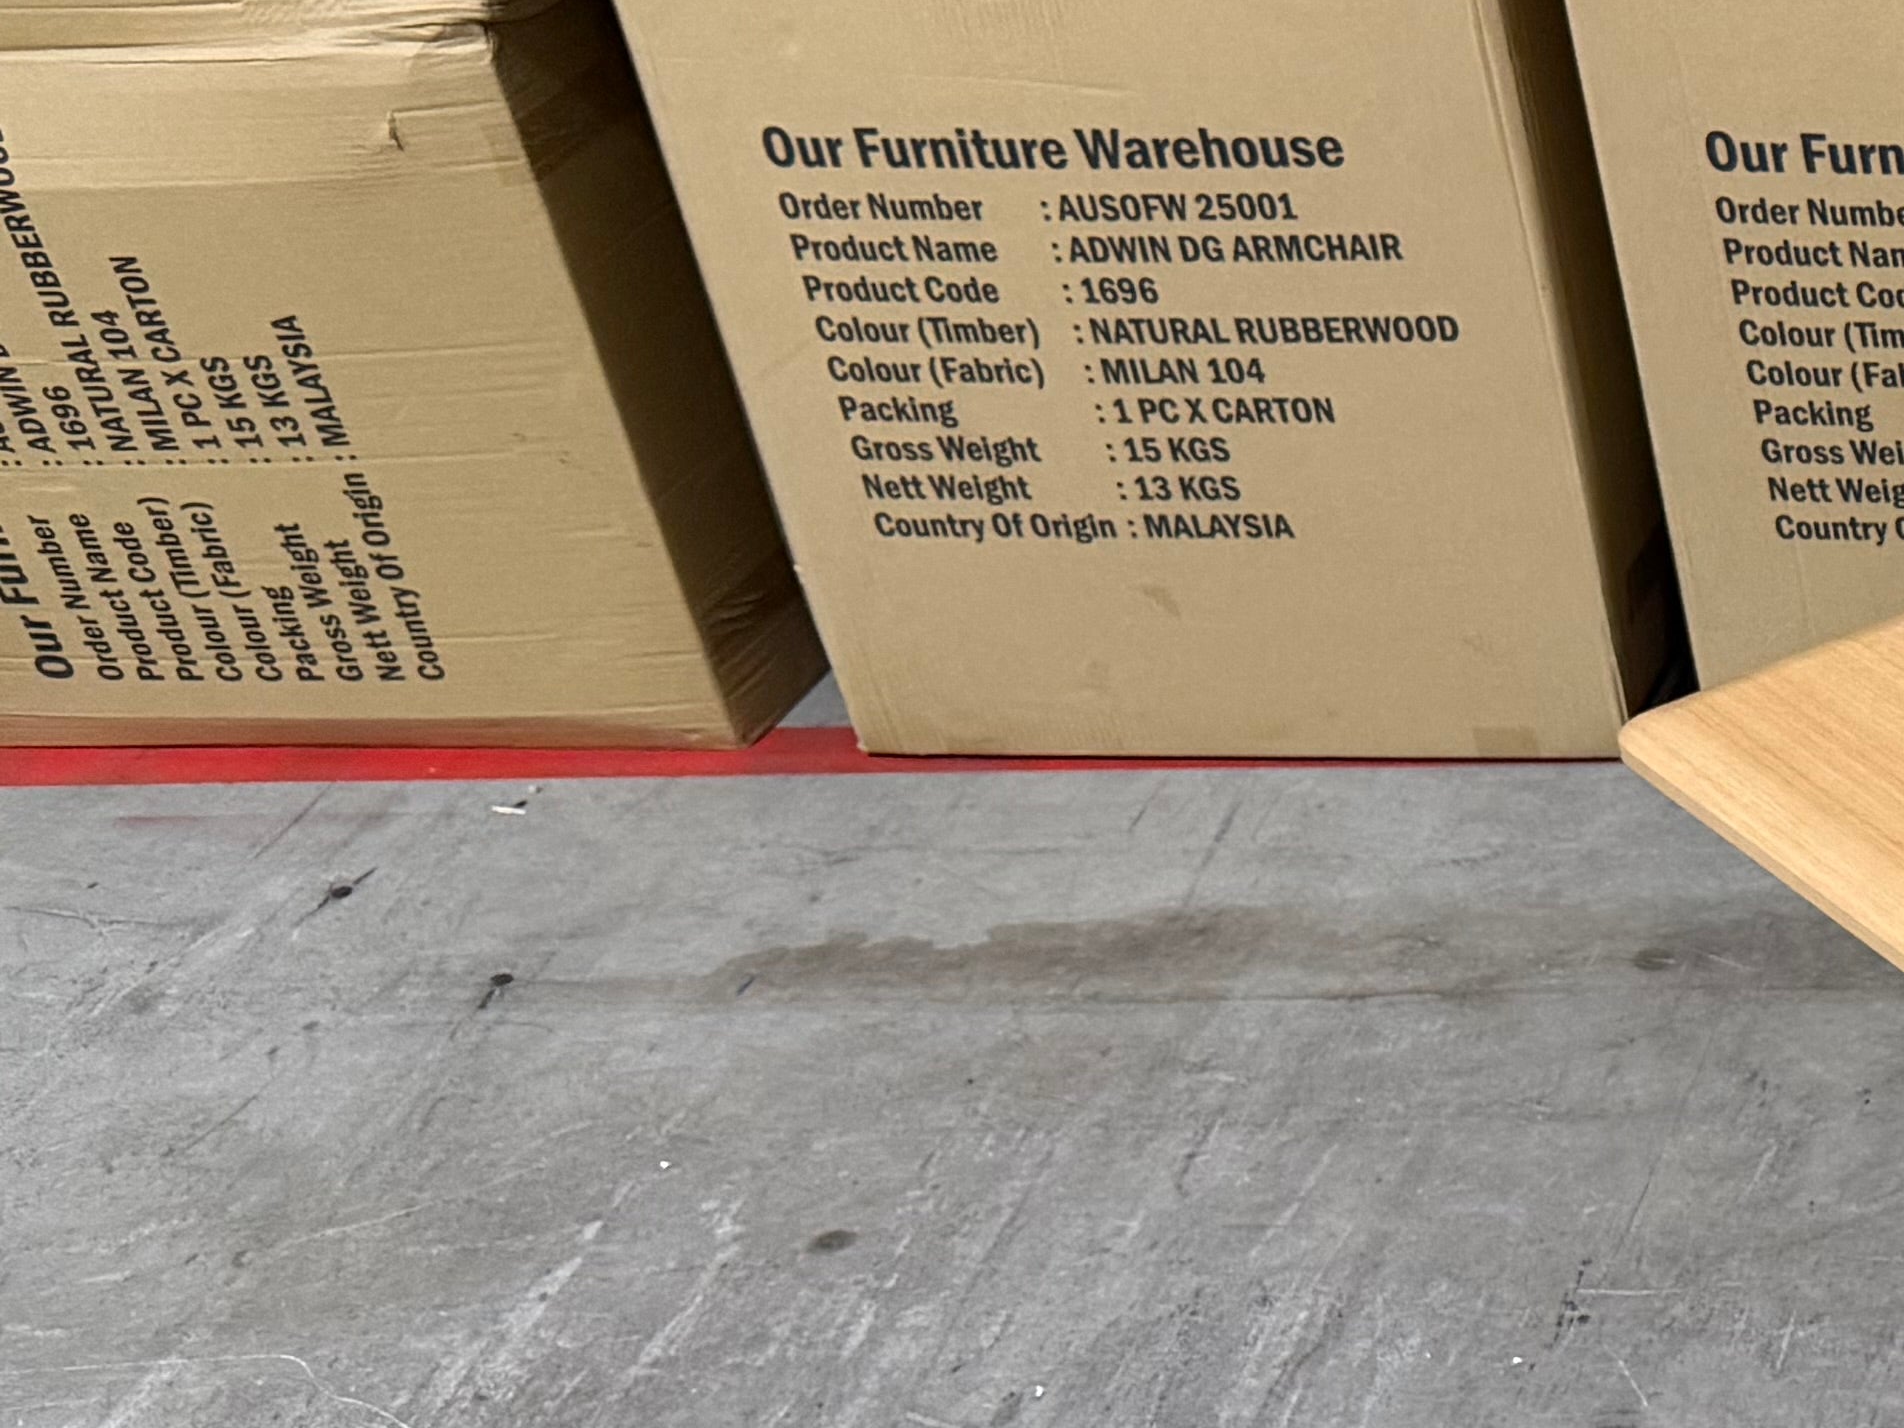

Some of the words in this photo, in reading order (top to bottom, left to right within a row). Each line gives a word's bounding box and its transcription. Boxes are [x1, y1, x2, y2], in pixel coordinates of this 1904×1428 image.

[761, 125, 844, 168] Our
[852, 127, 1069, 170] Furniture
[1072, 127, 1345, 170] Warehouse
[1705, 130, 1788, 173] Our
[789, 233, 910, 261] Product
[911, 234, 999, 262] Name
[1069, 235, 1172, 263] ADWIN
[1177, 235, 1226, 262] DG
[1232, 233, 1404, 262] ARMCHAIR
[107, 255, 182, 362] CARTON
[1730, 278, 1851, 308] Product
[1738, 319, 1836, 347] Colour
[160, 369, 194, 386] X
[269, 314, 351, 446] MALAYSIA
[41, 385, 96, 450] 1696
[172, 392, 212, 426] PC
[191, 434, 222, 448] 1
[1760, 438, 1845, 464] Gross
[341, 472, 391, 546] Origin
[861, 473, 927, 500] Nett
[927, 474, 1033, 505] Weight
[1134, 475, 1173, 501] 13
[1178, 475, 1241, 501] KGS
[112, 521, 156, 582] Code
[368, 552, 404, 580] Of
[138, 588, 204, 680] Product
[260, 585, 325, 681] Packing
[389, 586, 445, 680] Country
